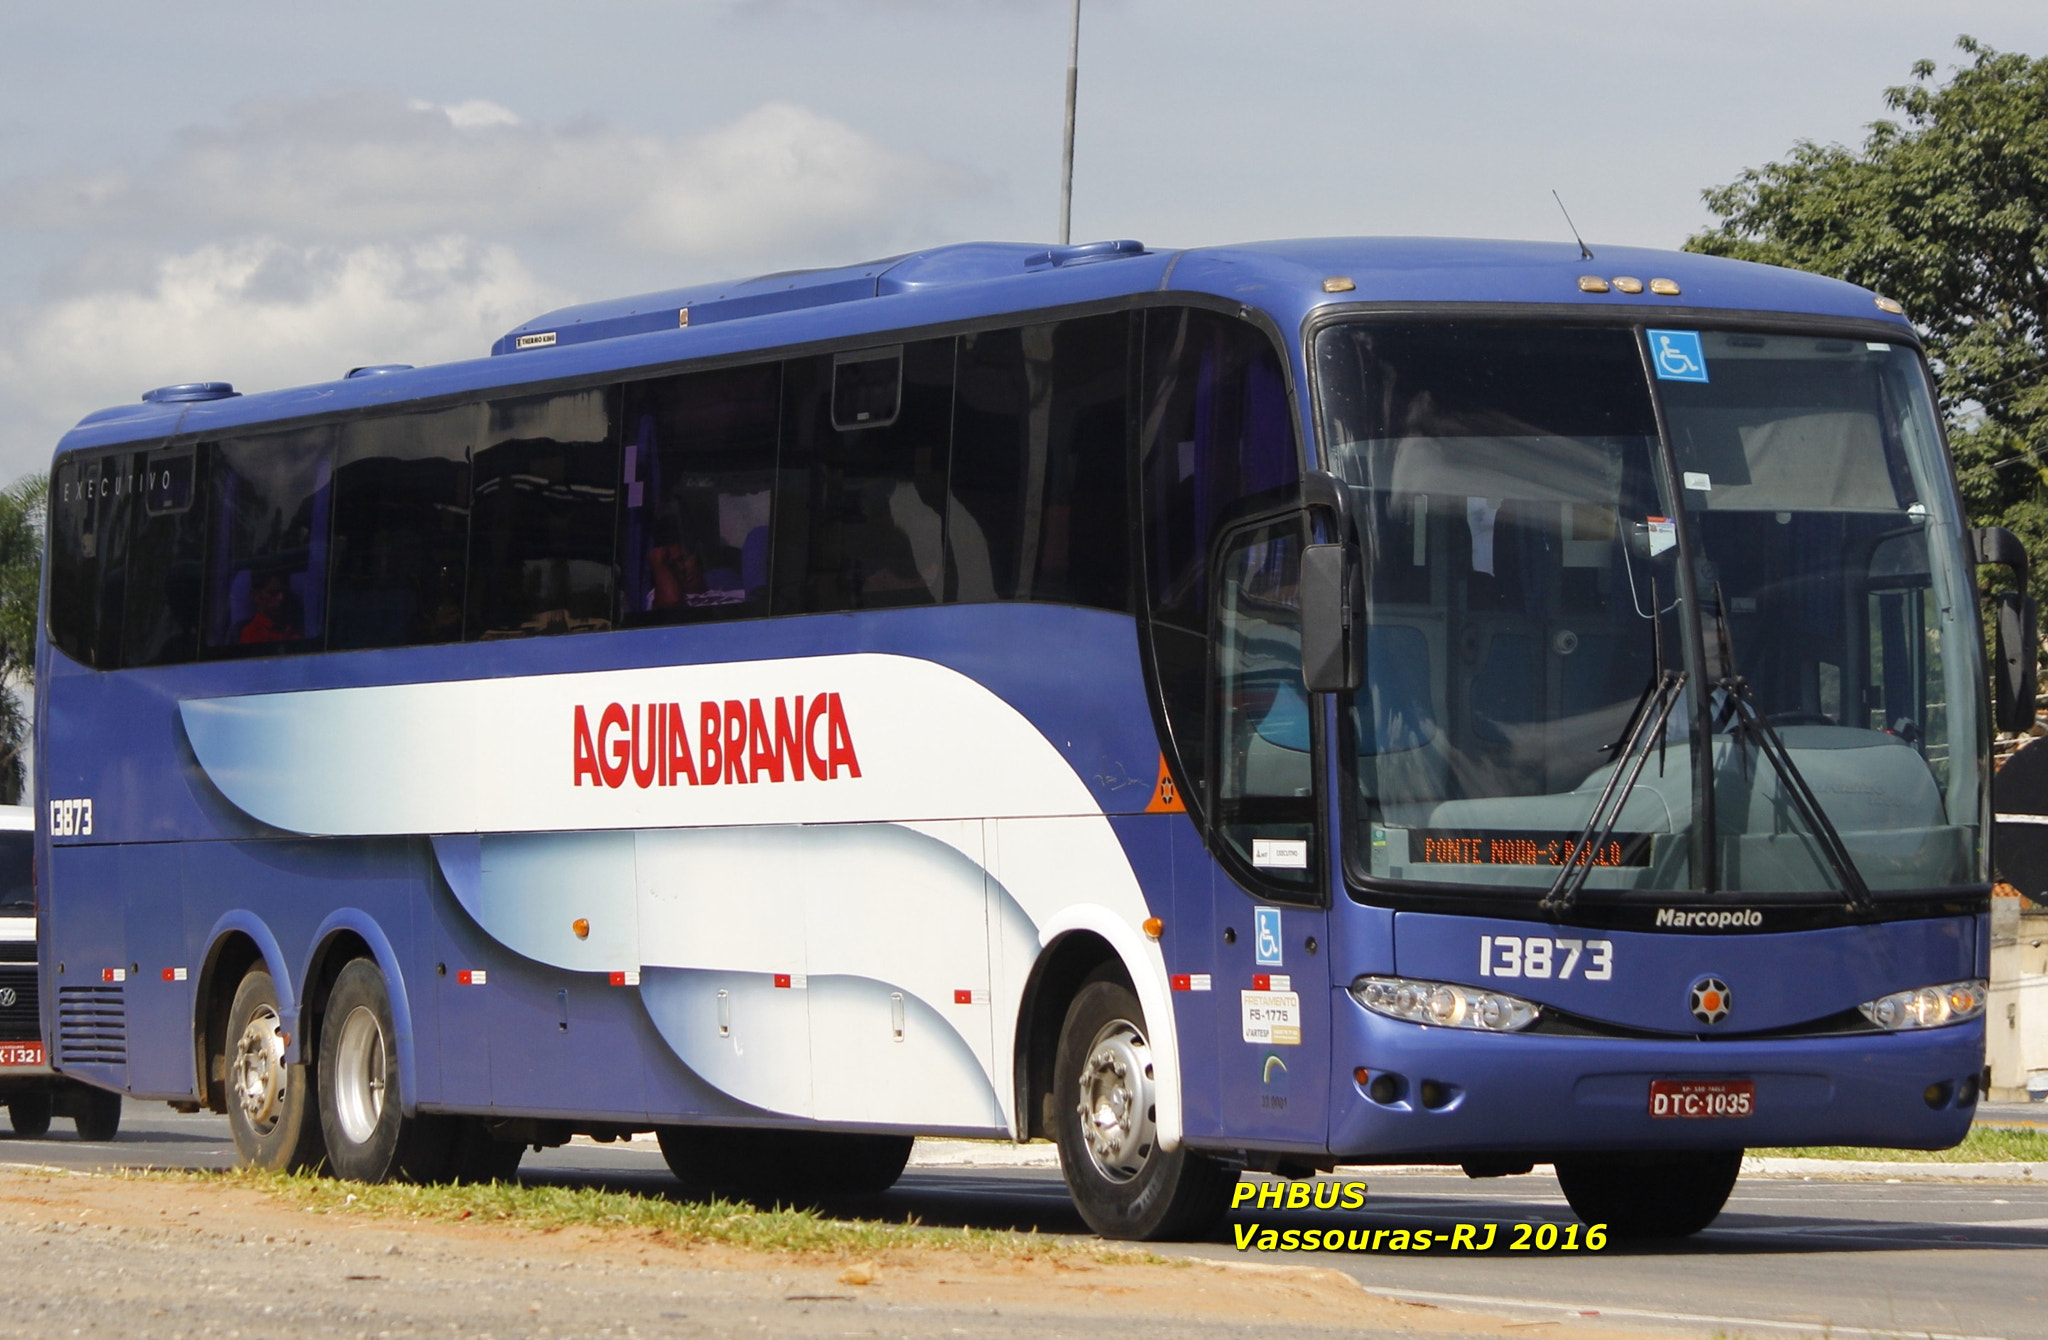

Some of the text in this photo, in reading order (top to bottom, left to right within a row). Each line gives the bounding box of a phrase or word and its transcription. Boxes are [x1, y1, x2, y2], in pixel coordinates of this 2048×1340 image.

[63, 470, 171, 502] EXECUTIVO
[574, 692, 862, 789] AGUIA BRANCA
[50, 799, 93, 836] 13873
[1424, 837, 1483, 864] PONTE
[1655, 908, 1763, 929] Marcopolo
[1479, 935, 1614, 981] 13873
[1244, 995, 1298, 1007] FRETAMENTO
[1249, 1008, 1289, 1022] F5-1775
